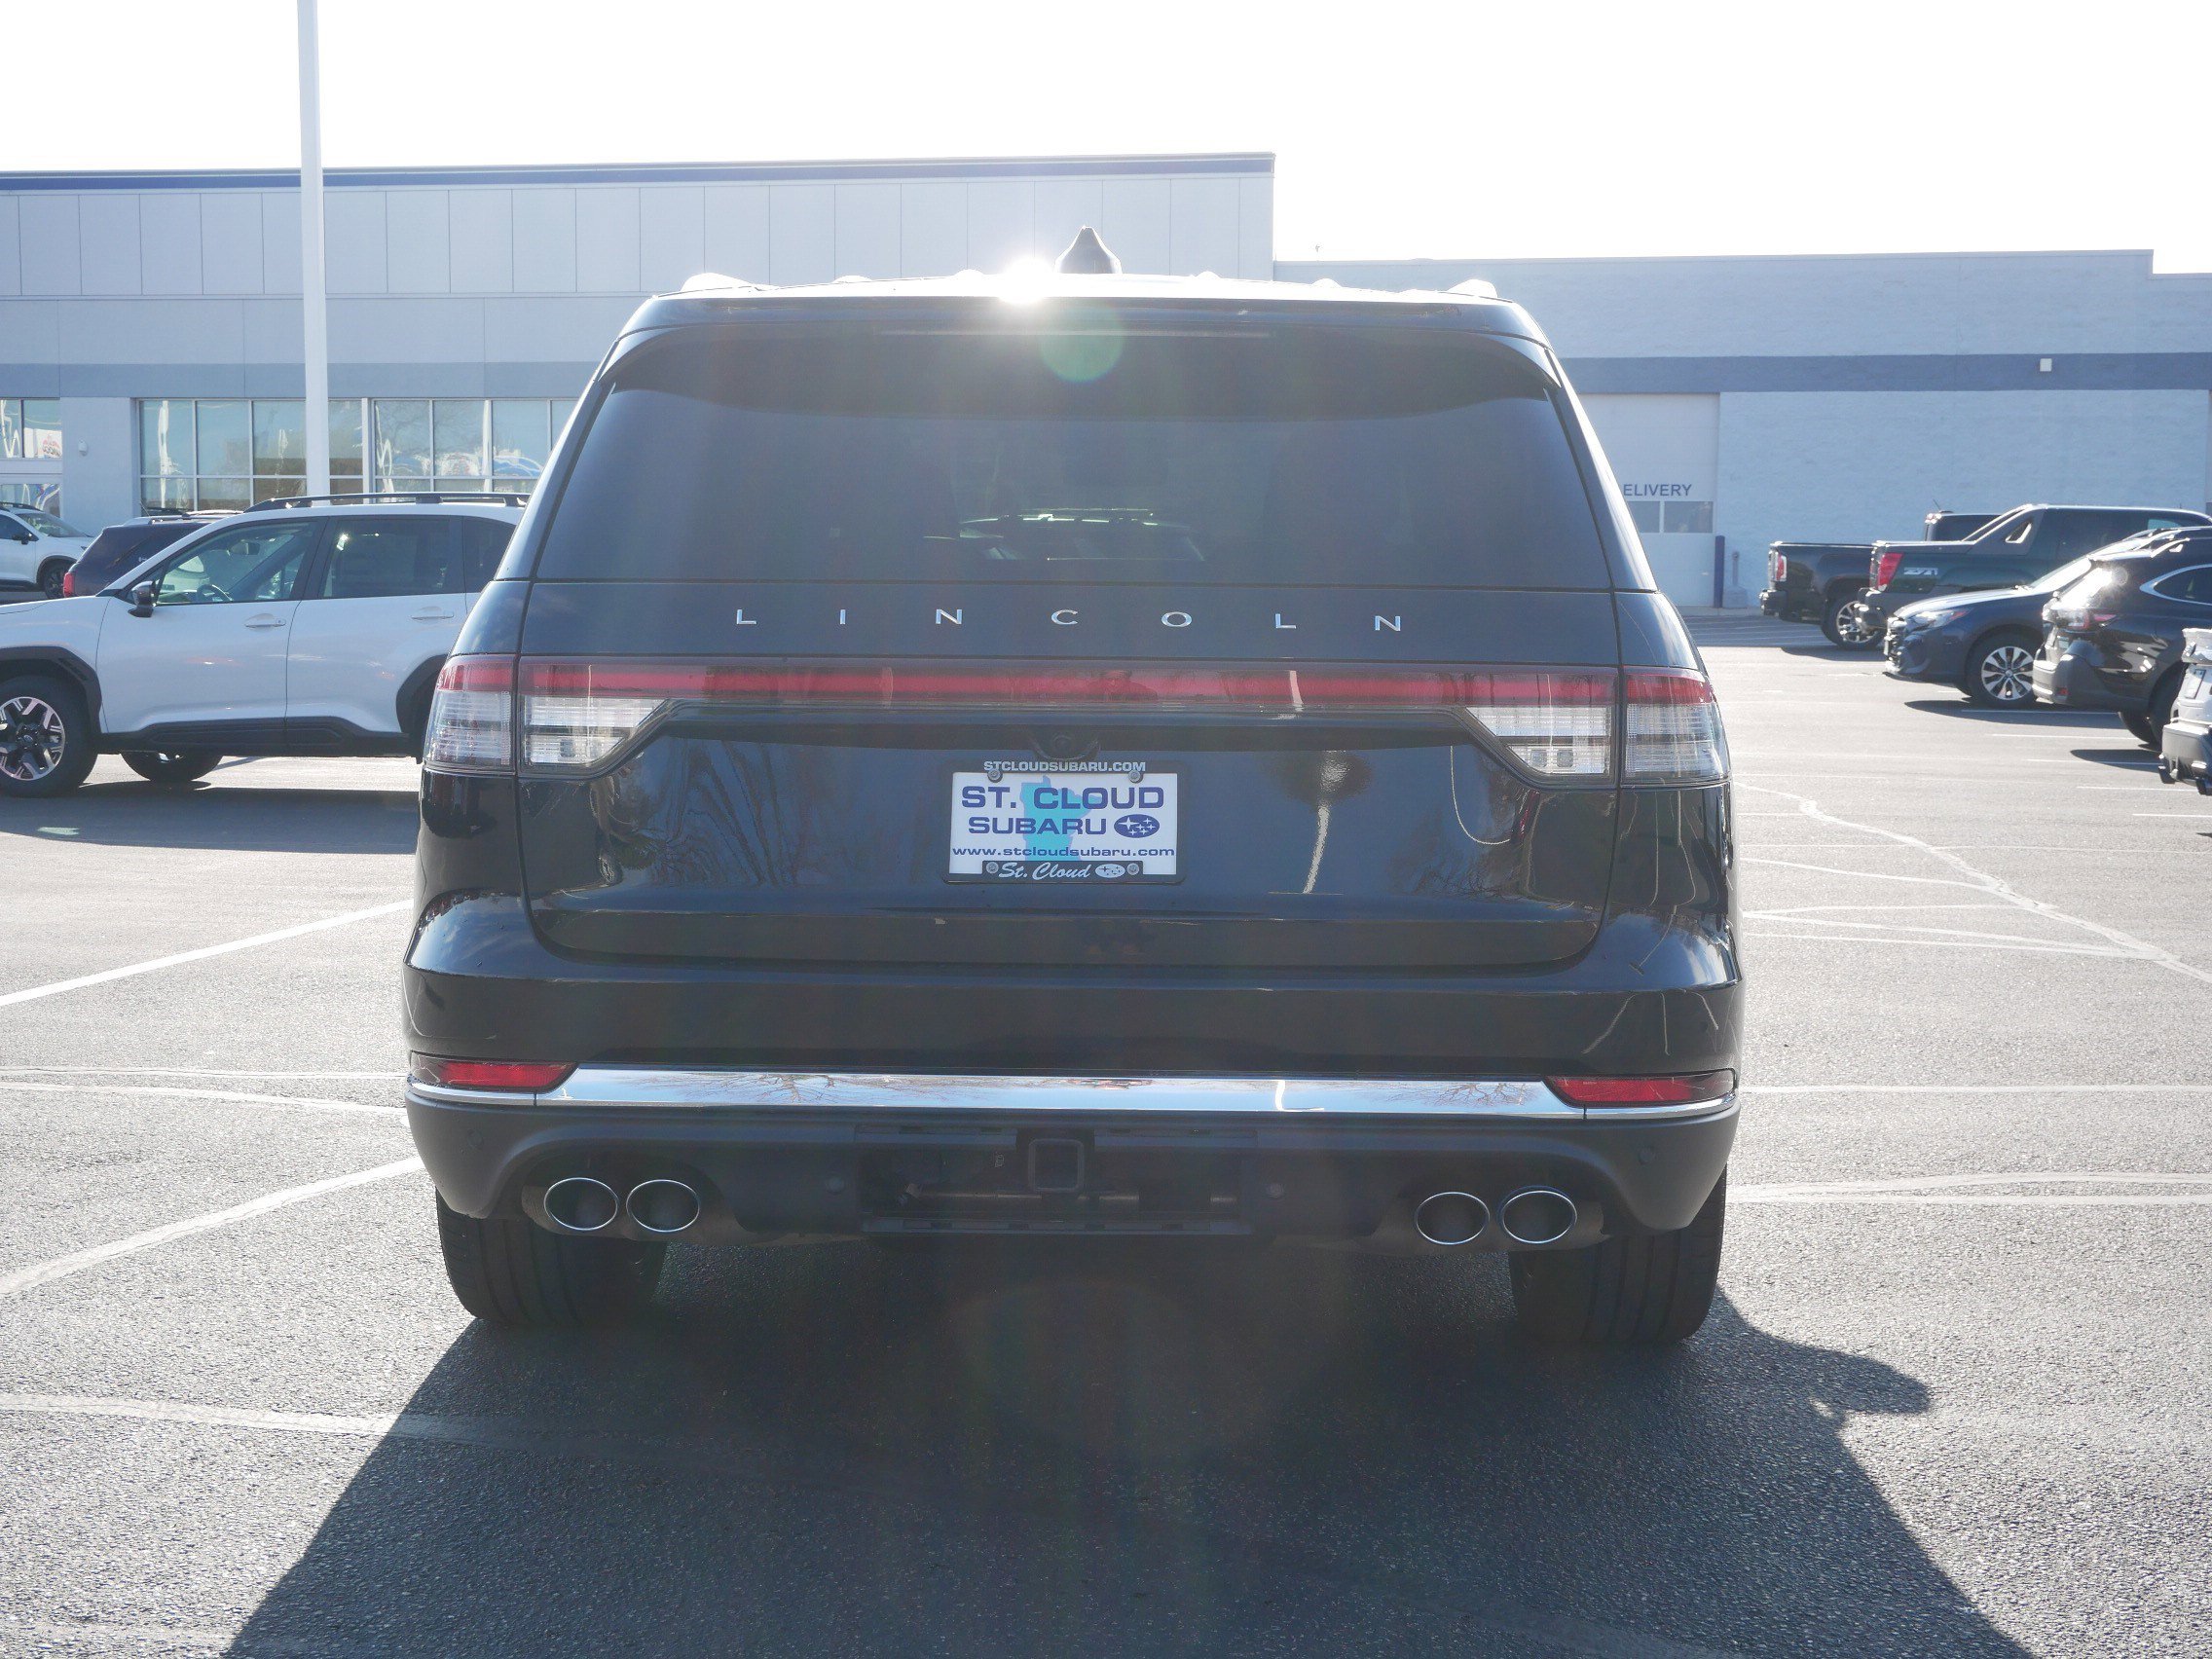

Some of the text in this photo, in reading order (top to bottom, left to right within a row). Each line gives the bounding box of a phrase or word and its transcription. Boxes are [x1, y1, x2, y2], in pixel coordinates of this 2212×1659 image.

[1623, 483, 1692, 497] ELIVERY
[736, 608, 1402, 632] LINCOLN
[983, 760, 1146, 772] STCLOUDSUBARU.COM
[961, 786, 1164, 809] ST. CLOUD
[968, 816, 1107, 835] SUBARU
[952, 847, 1175, 857] www.stcloudsubaru.com
[998, 862, 1092, 880] St. Cloud
